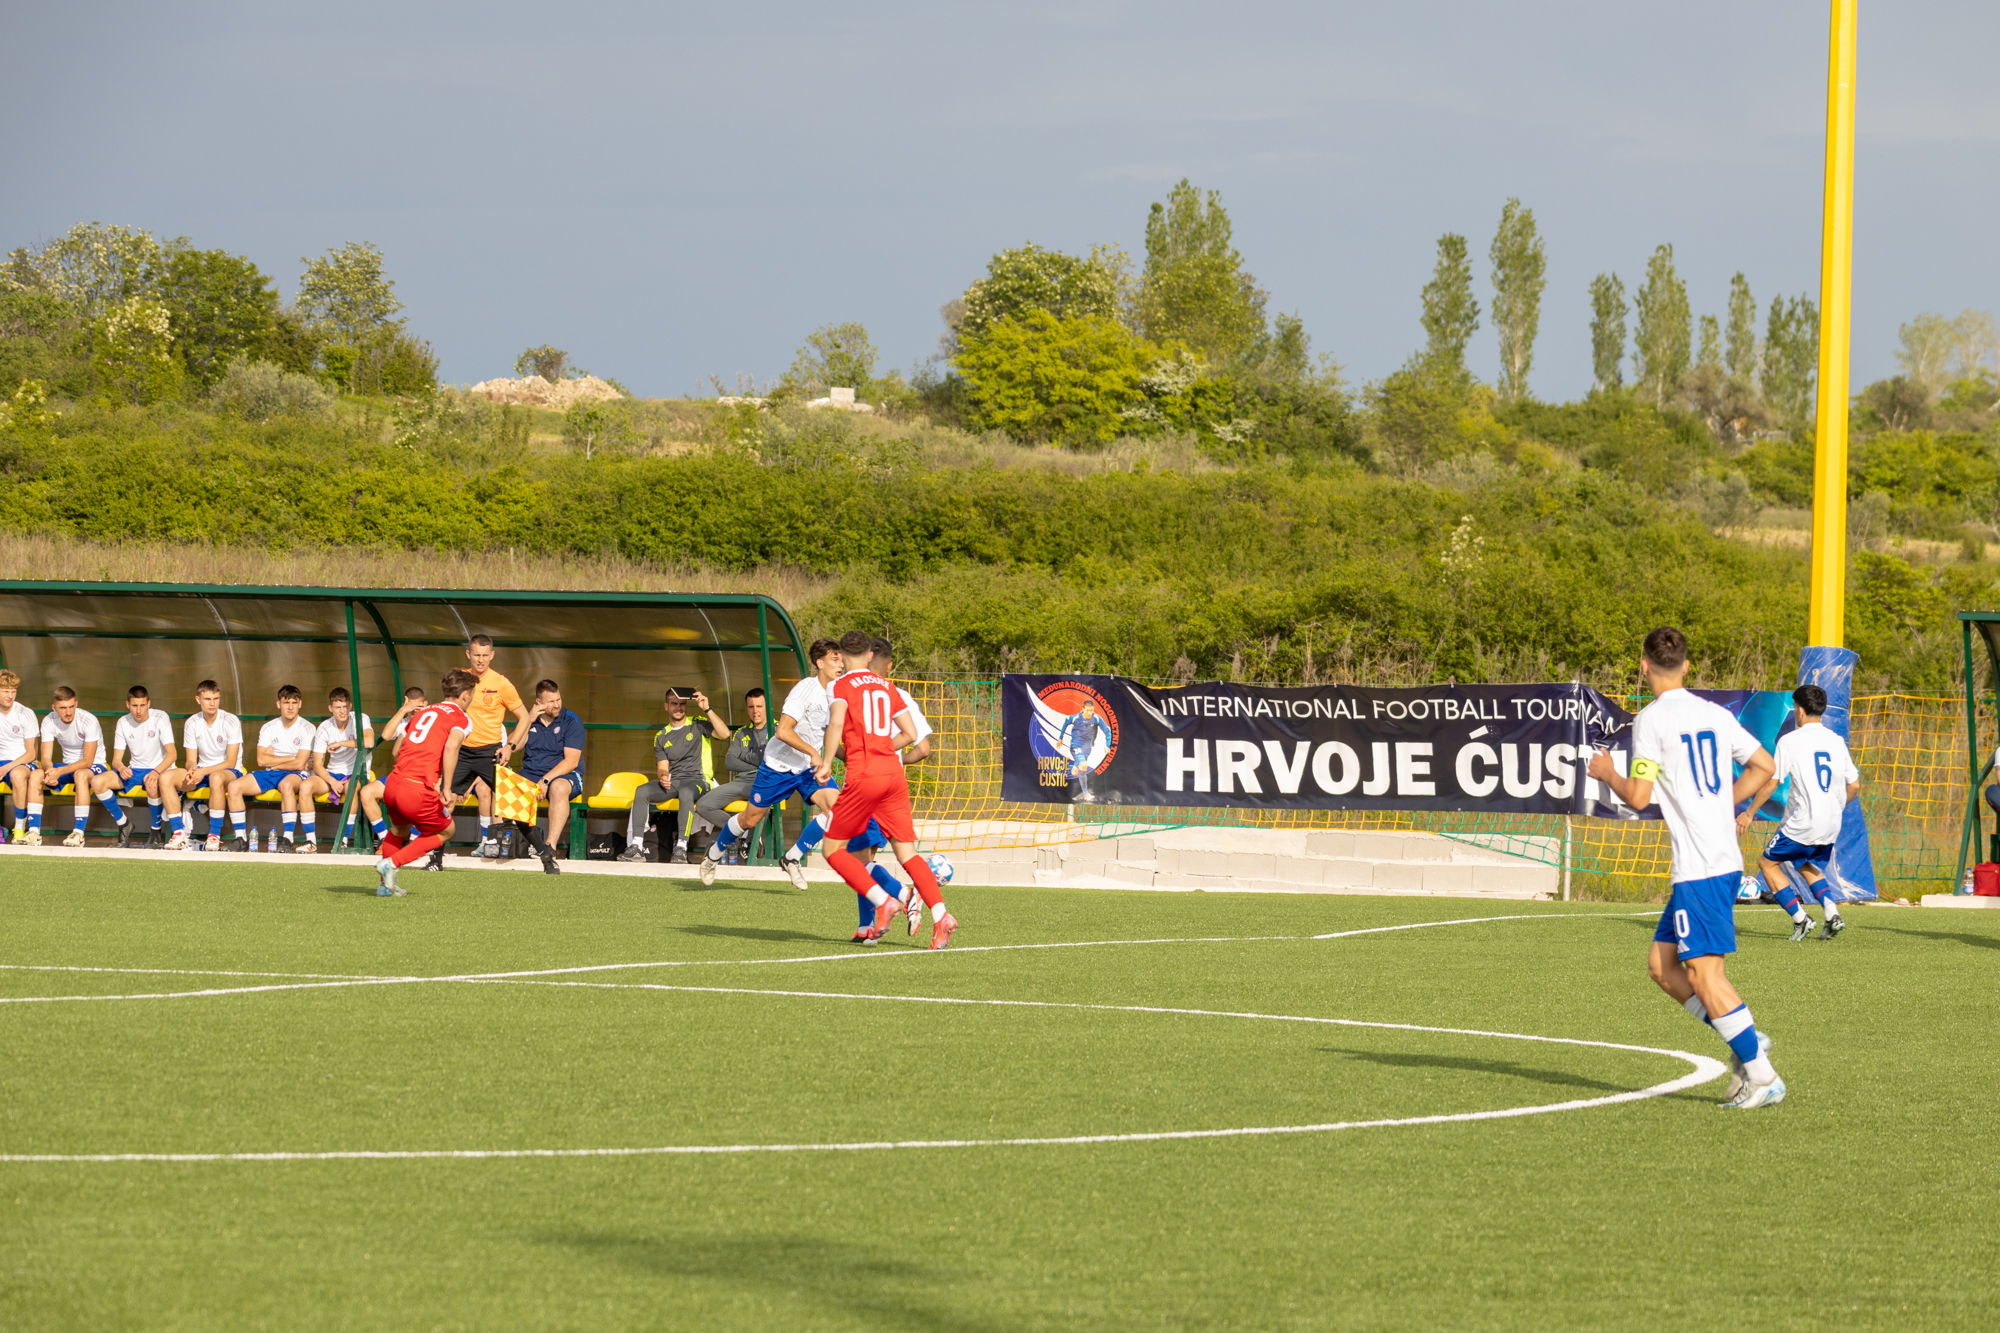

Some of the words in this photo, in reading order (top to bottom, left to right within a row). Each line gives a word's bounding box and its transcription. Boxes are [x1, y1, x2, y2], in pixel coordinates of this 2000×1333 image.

[408, 711, 439, 744] 9
[862, 689, 891, 737] 10
[1094, 692, 1120, 745] NOGOMETNI
[1160, 695, 1366, 720] INTERNATIONAL
[1372, 698, 1506, 720] FOOTBALL
[1511, 698, 1634, 735] TOURNAM
[1037, 756, 1071, 770] HRVOJE
[1039, 769, 1069, 788] ĆUSTIĆ
[1094, 745, 1118, 776] TURNIR
[1165, 737, 1436, 796] HRVOJE
[1455, 724, 1661, 805] ĆUSTI
[1635, 761, 1648, 775] C
[1680, 730, 1721, 798] 10
[1814, 751, 1832, 793] 6
[1672, 908, 1691, 939] 0
